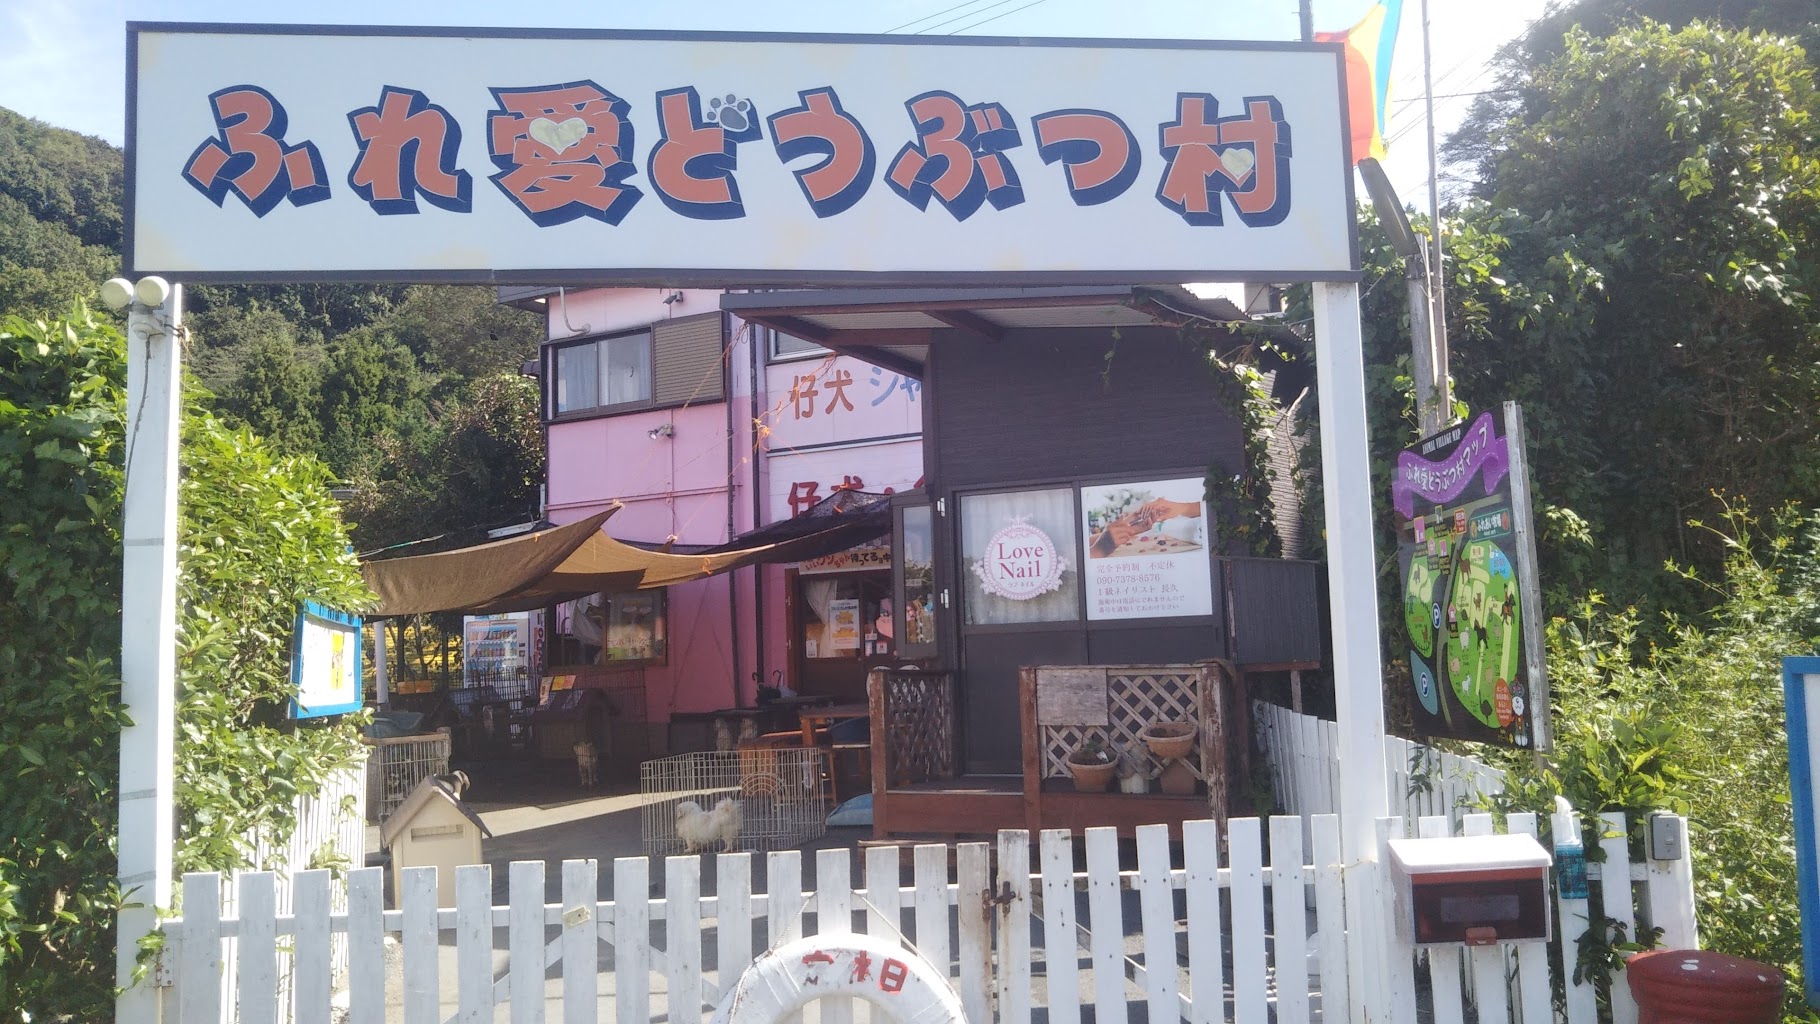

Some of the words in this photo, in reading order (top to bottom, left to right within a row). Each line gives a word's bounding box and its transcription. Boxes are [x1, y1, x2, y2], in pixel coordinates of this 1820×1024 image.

[181, 79, 1292, 228] ふれ愛どうぶつ村
[790, 368, 853, 420] 仔犬
[1405, 421, 1488, 493] ふれ愛どうぶつ村マップ
[997, 542, 1044, 560] Love
[1096, 562, 1140, 574] 完全予約制
[1150, 560, 1175, 571] 不定休
[998, 559, 1041, 580] Nail
